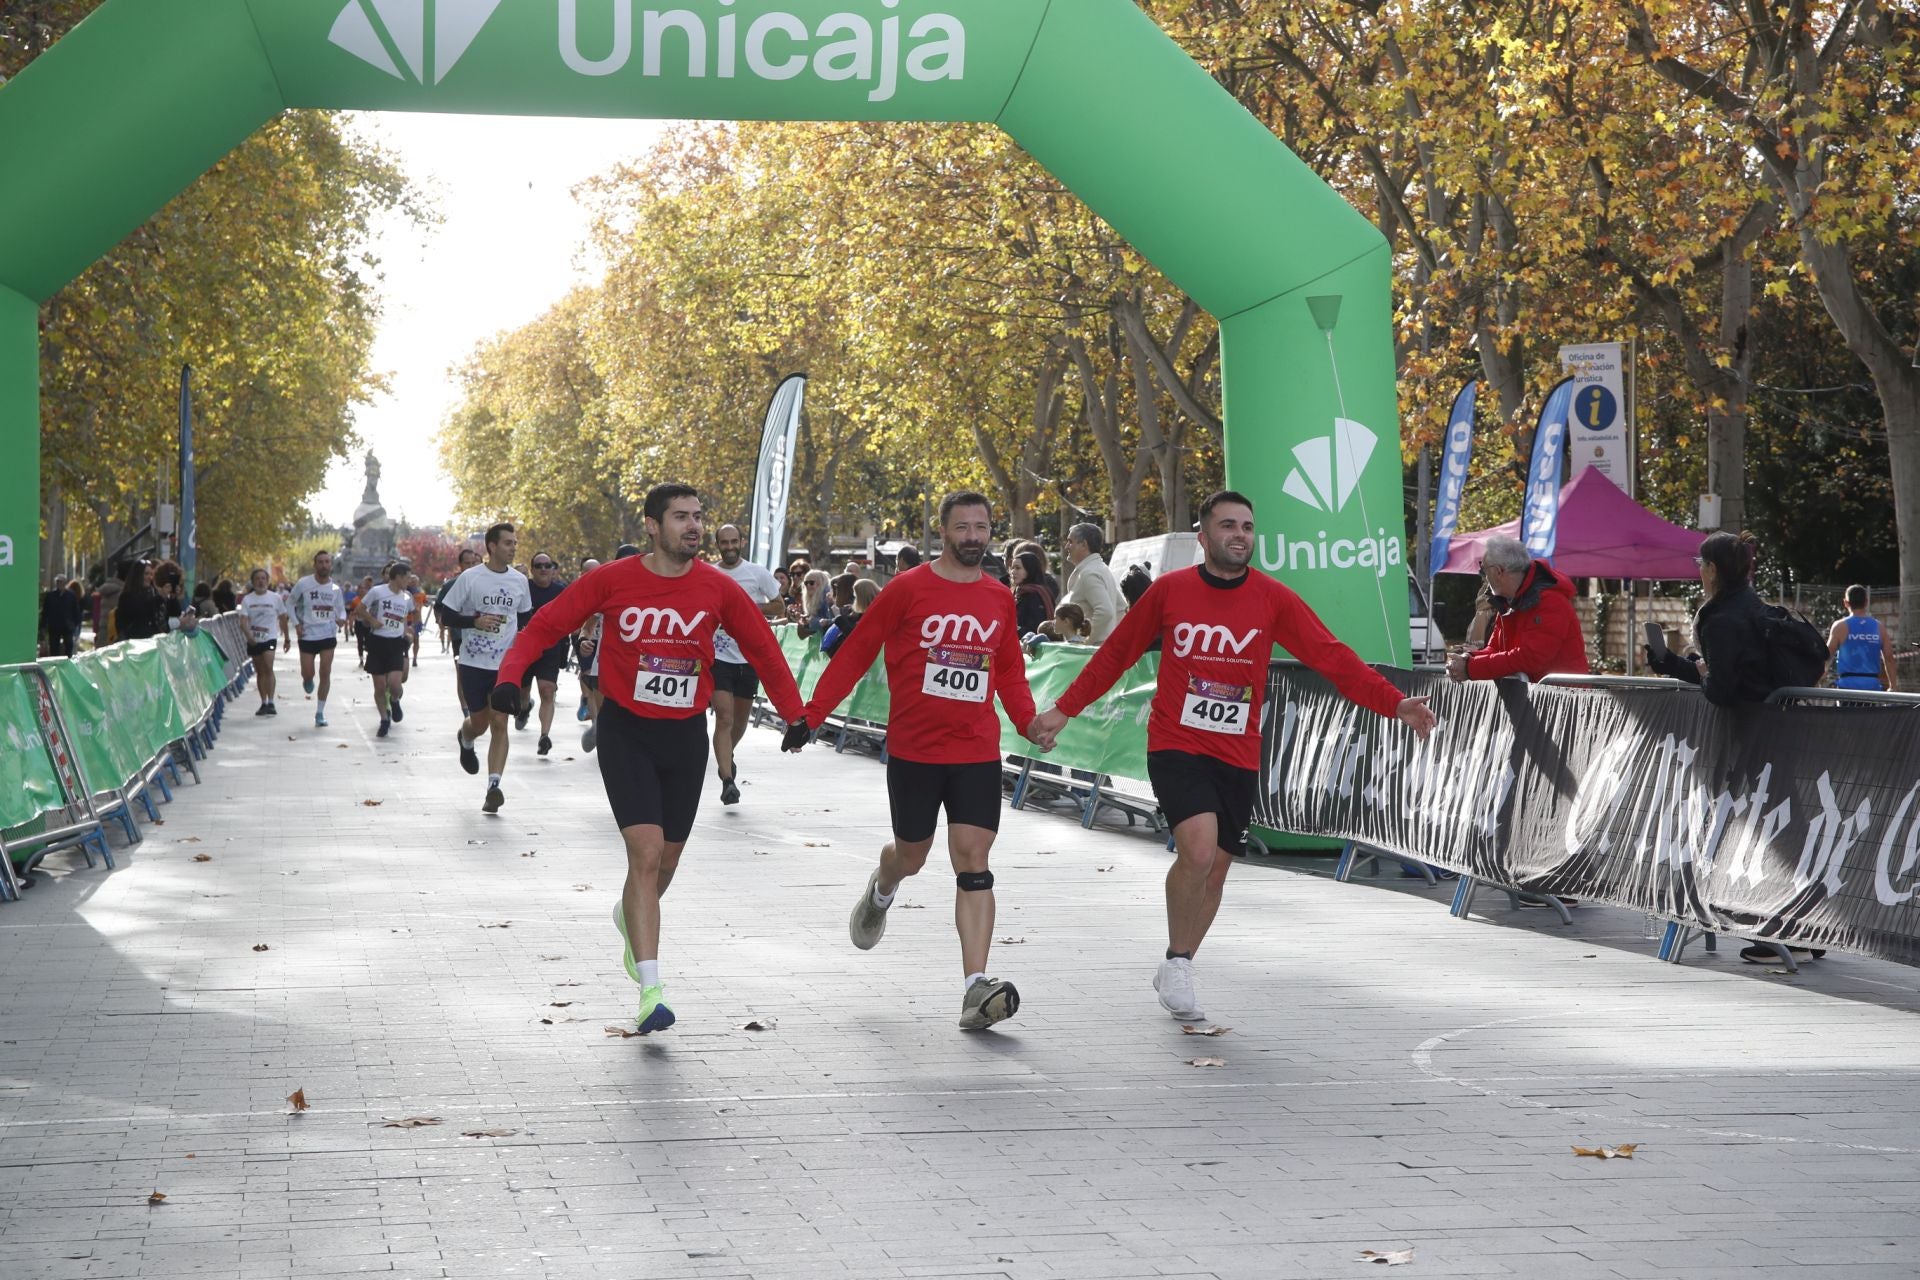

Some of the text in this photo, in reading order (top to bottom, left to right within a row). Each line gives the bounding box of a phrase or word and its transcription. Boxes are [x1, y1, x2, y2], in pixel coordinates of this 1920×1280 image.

[558, 0, 966, 102] Unicaja
[1568, 352, 1605, 361] Oficina de
[1435, 421, 1472, 539] IVECO
[1259, 527, 1401, 578] Unicaja
[482, 595, 514, 607] curia
[315, 611, 330, 619] 151
[385, 619, 400, 629] 153
[619, 606, 707, 643] gmv
[919, 613, 999, 649] gmv
[1173, 622, 1260, 658] gmv
[1848, 633, 1880, 641] IVECO
[1192, 655, 1226, 663] INNOVATING
[645, 675, 689, 697] 401
[933, 668, 979, 692] 400
[1192, 699, 1240, 724] 402
[1633, 732, 1791, 890] Norte
[1792, 769, 1872, 899] de
